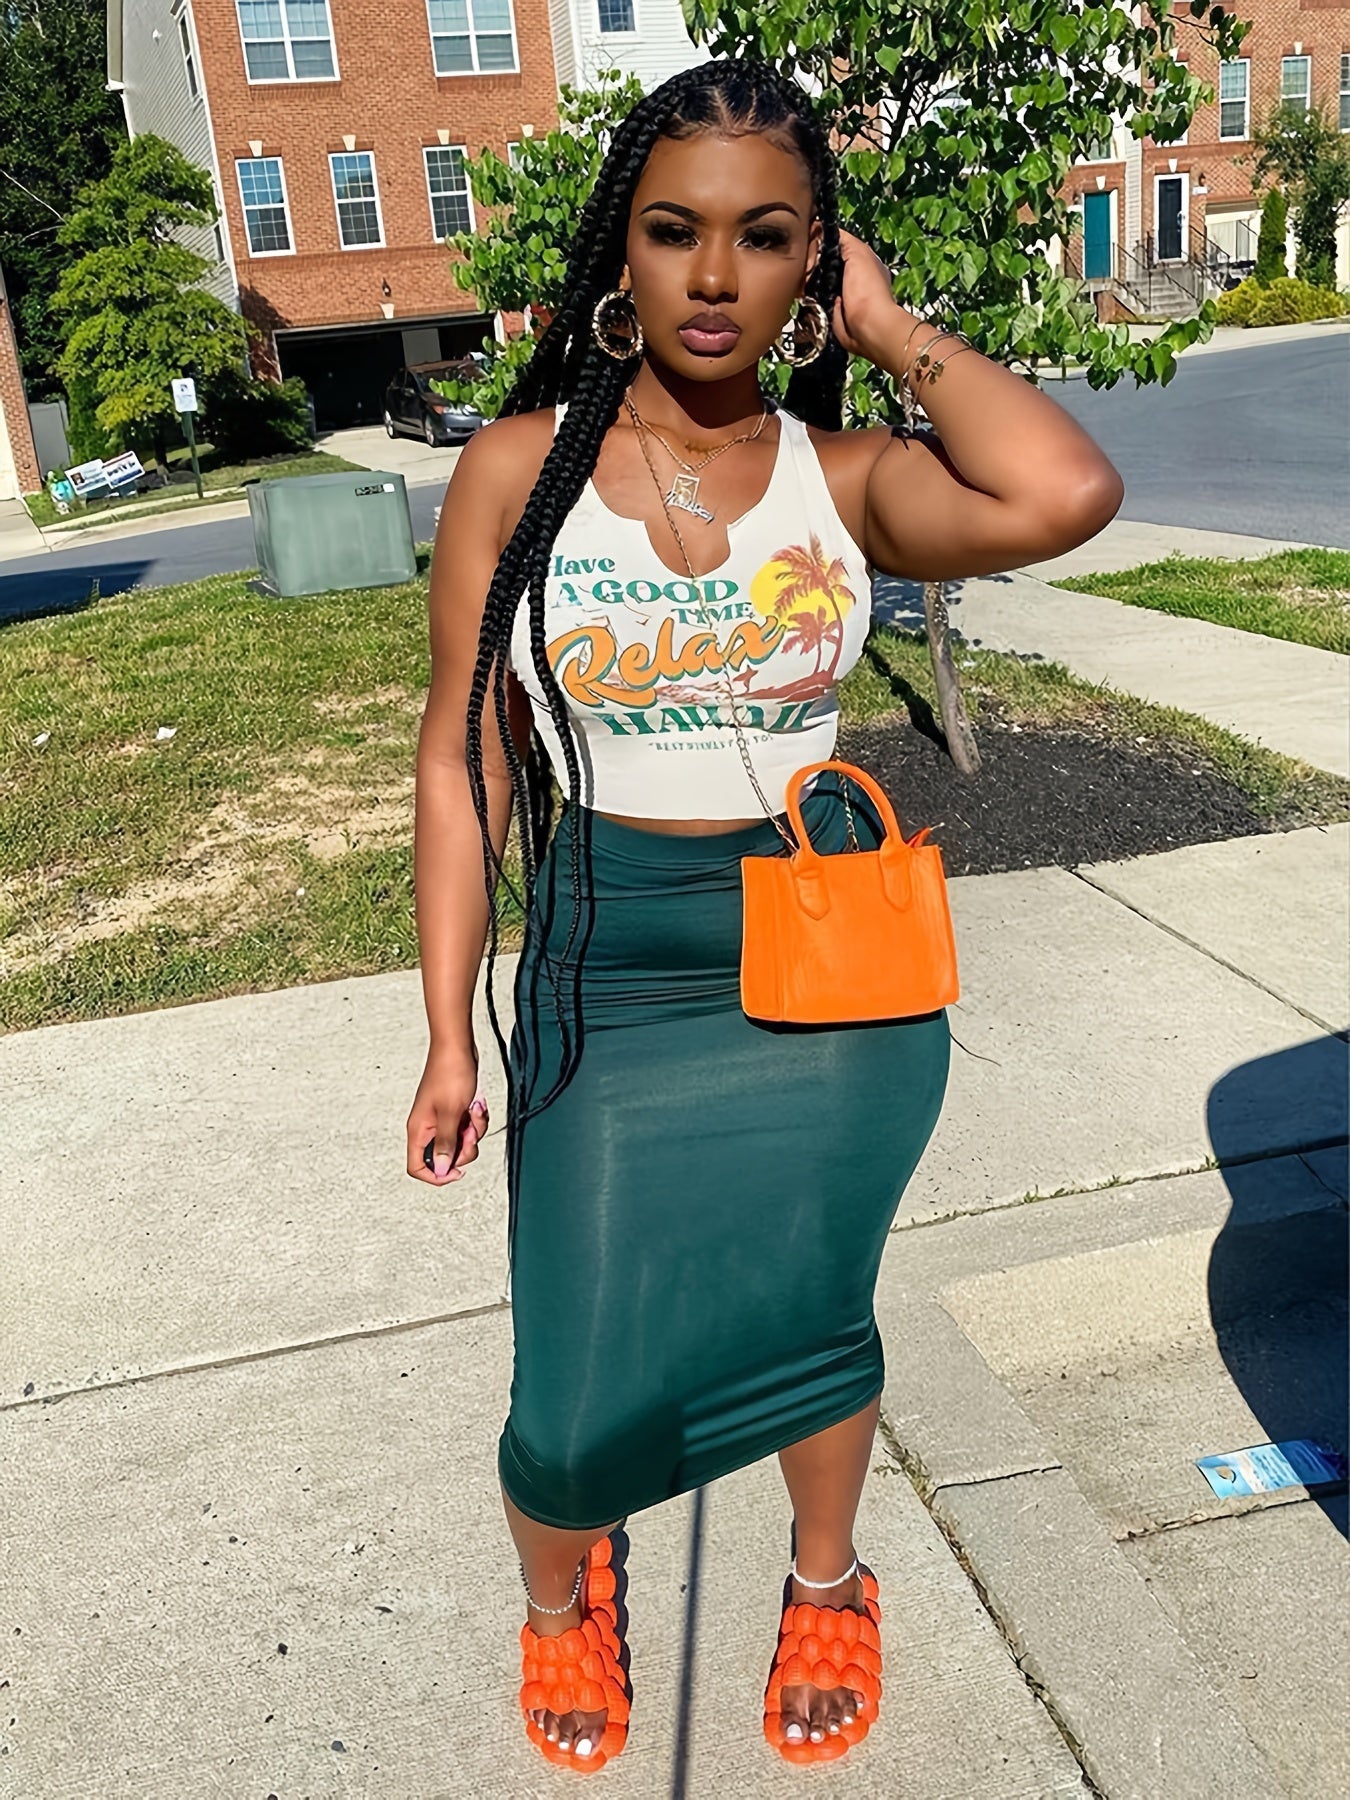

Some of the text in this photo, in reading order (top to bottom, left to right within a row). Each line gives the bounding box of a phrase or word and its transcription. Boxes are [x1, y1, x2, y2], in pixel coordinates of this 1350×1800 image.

[592, 580, 738, 603] GOOD
[671, 602, 755, 625] TIME
[546, 615, 787, 709] Relax
[594, 701, 815, 735] HAWAII
